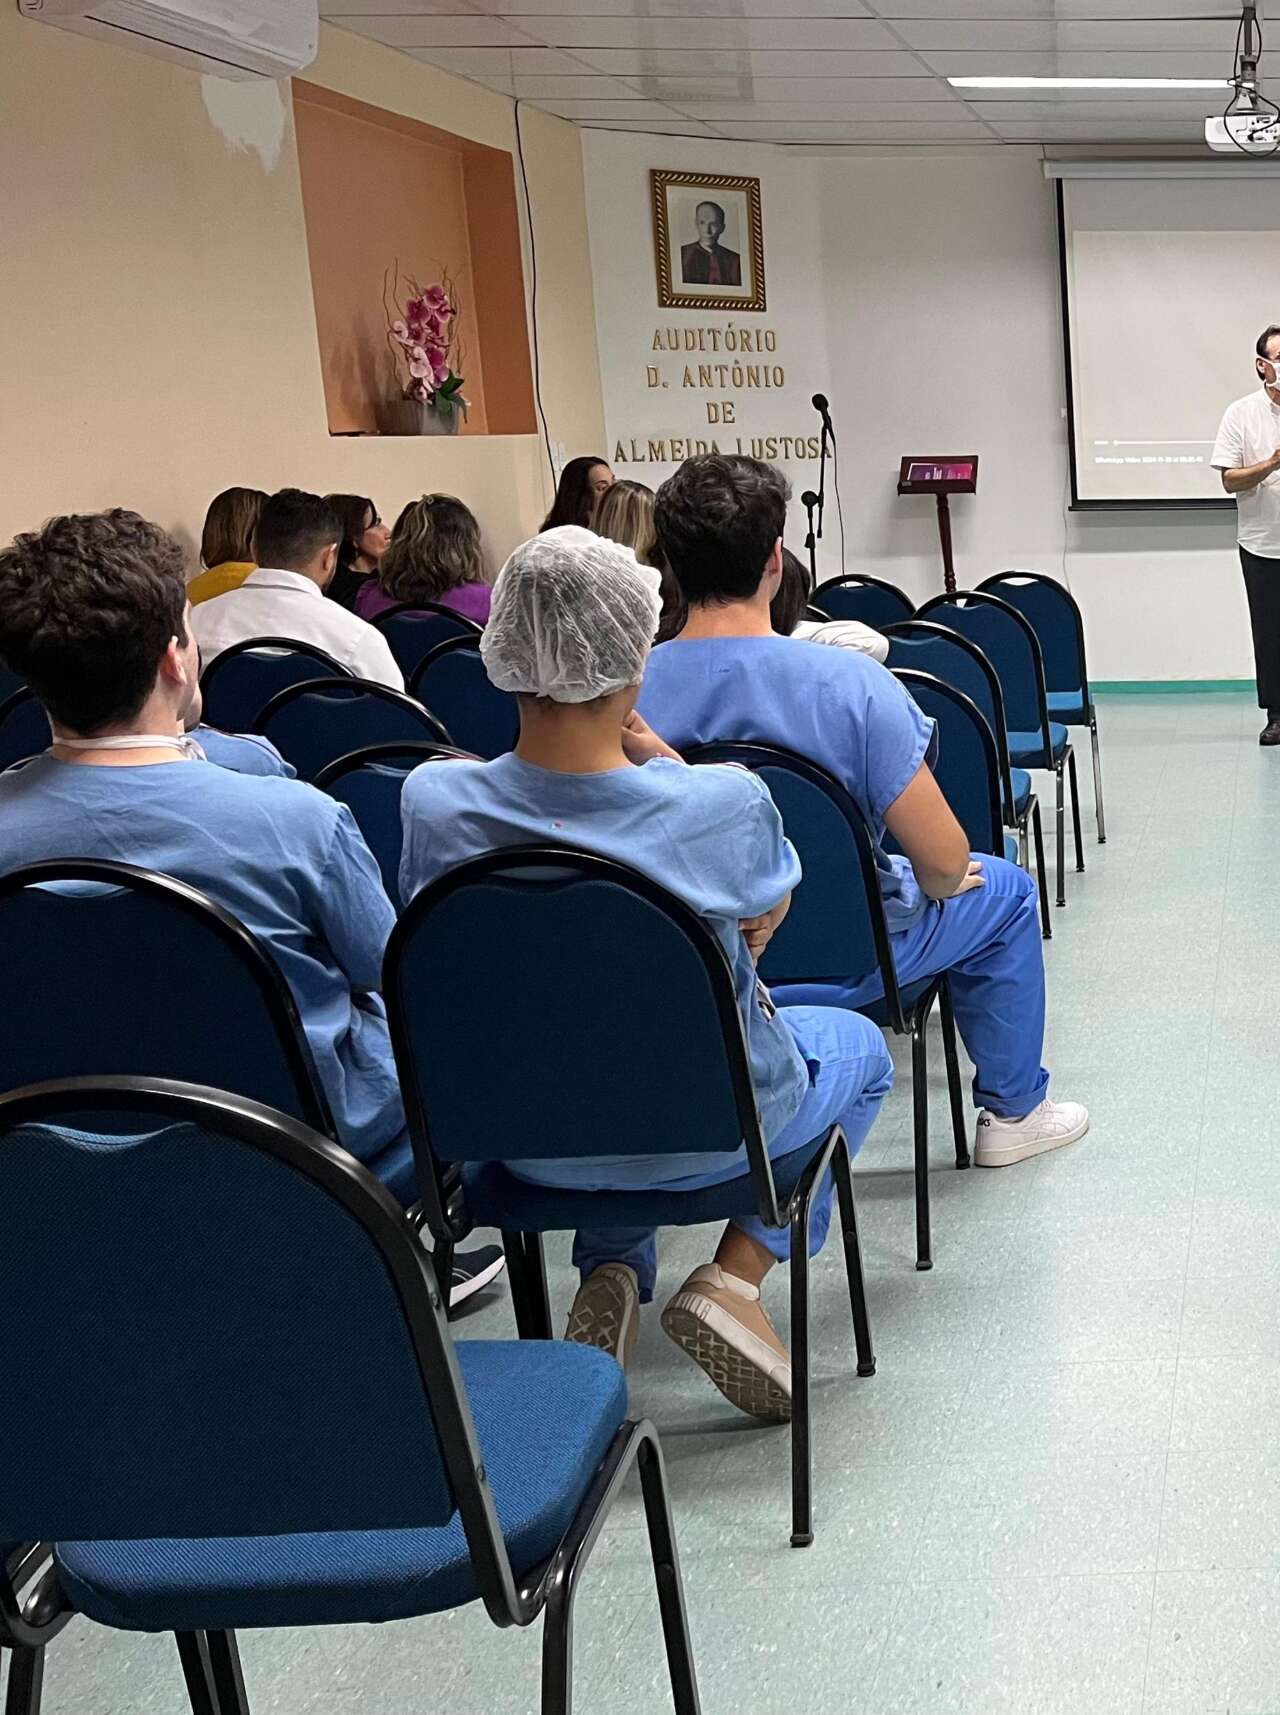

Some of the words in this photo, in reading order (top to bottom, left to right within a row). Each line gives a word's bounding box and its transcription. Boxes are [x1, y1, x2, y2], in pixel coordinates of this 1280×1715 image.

[652, 322, 777, 352] AUDITÓRIO
[646, 365, 669, 388] D.
[682, 360, 785, 388] ANTÔNIO
[706, 401, 736, 424] DE
[614, 438, 720, 463] ALMEIDA
[736, 436, 832, 460] LUSTOSA
